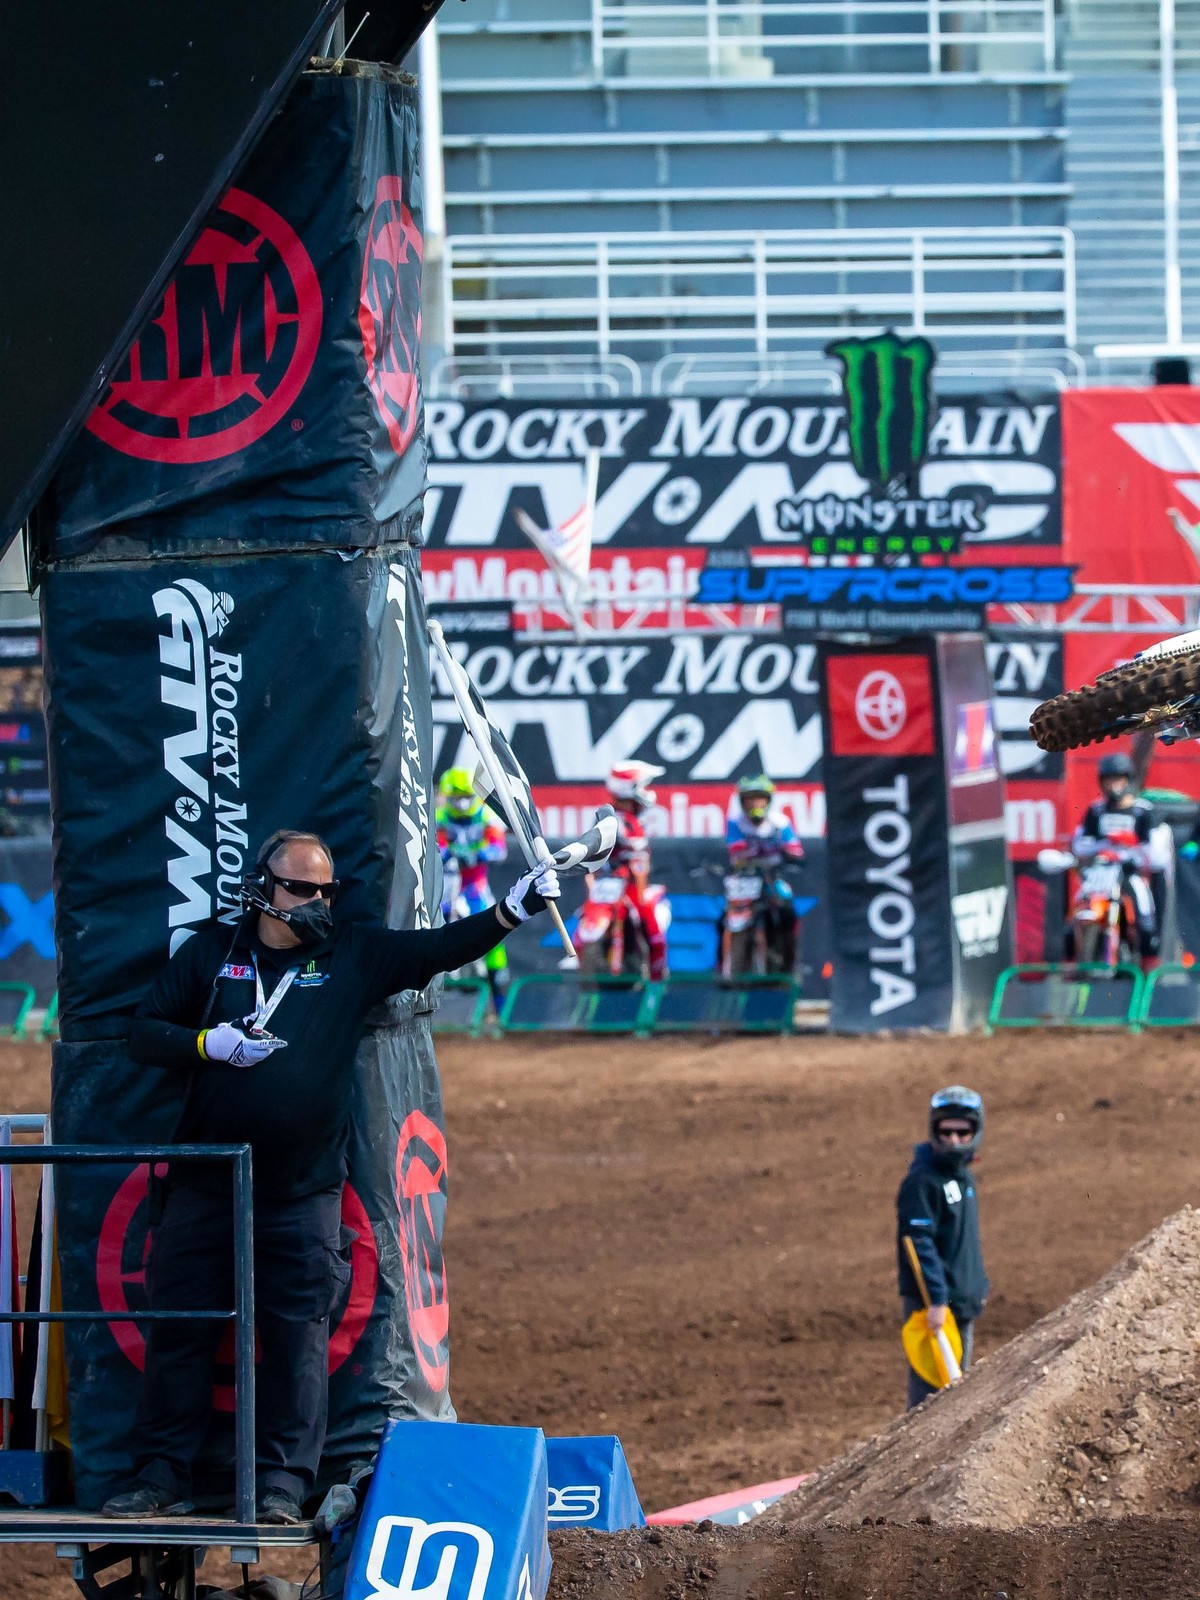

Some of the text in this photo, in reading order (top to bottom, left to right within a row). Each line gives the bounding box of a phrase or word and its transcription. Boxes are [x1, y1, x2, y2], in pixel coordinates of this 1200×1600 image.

[648, 398, 1057, 459] MOUAIN
[778, 496, 985, 535] MONSTER
[697, 566, 1075, 602] SUPERCROSS
[209, 644, 244, 788] ROCKY
[861, 773, 918, 1017] TOYOTA
